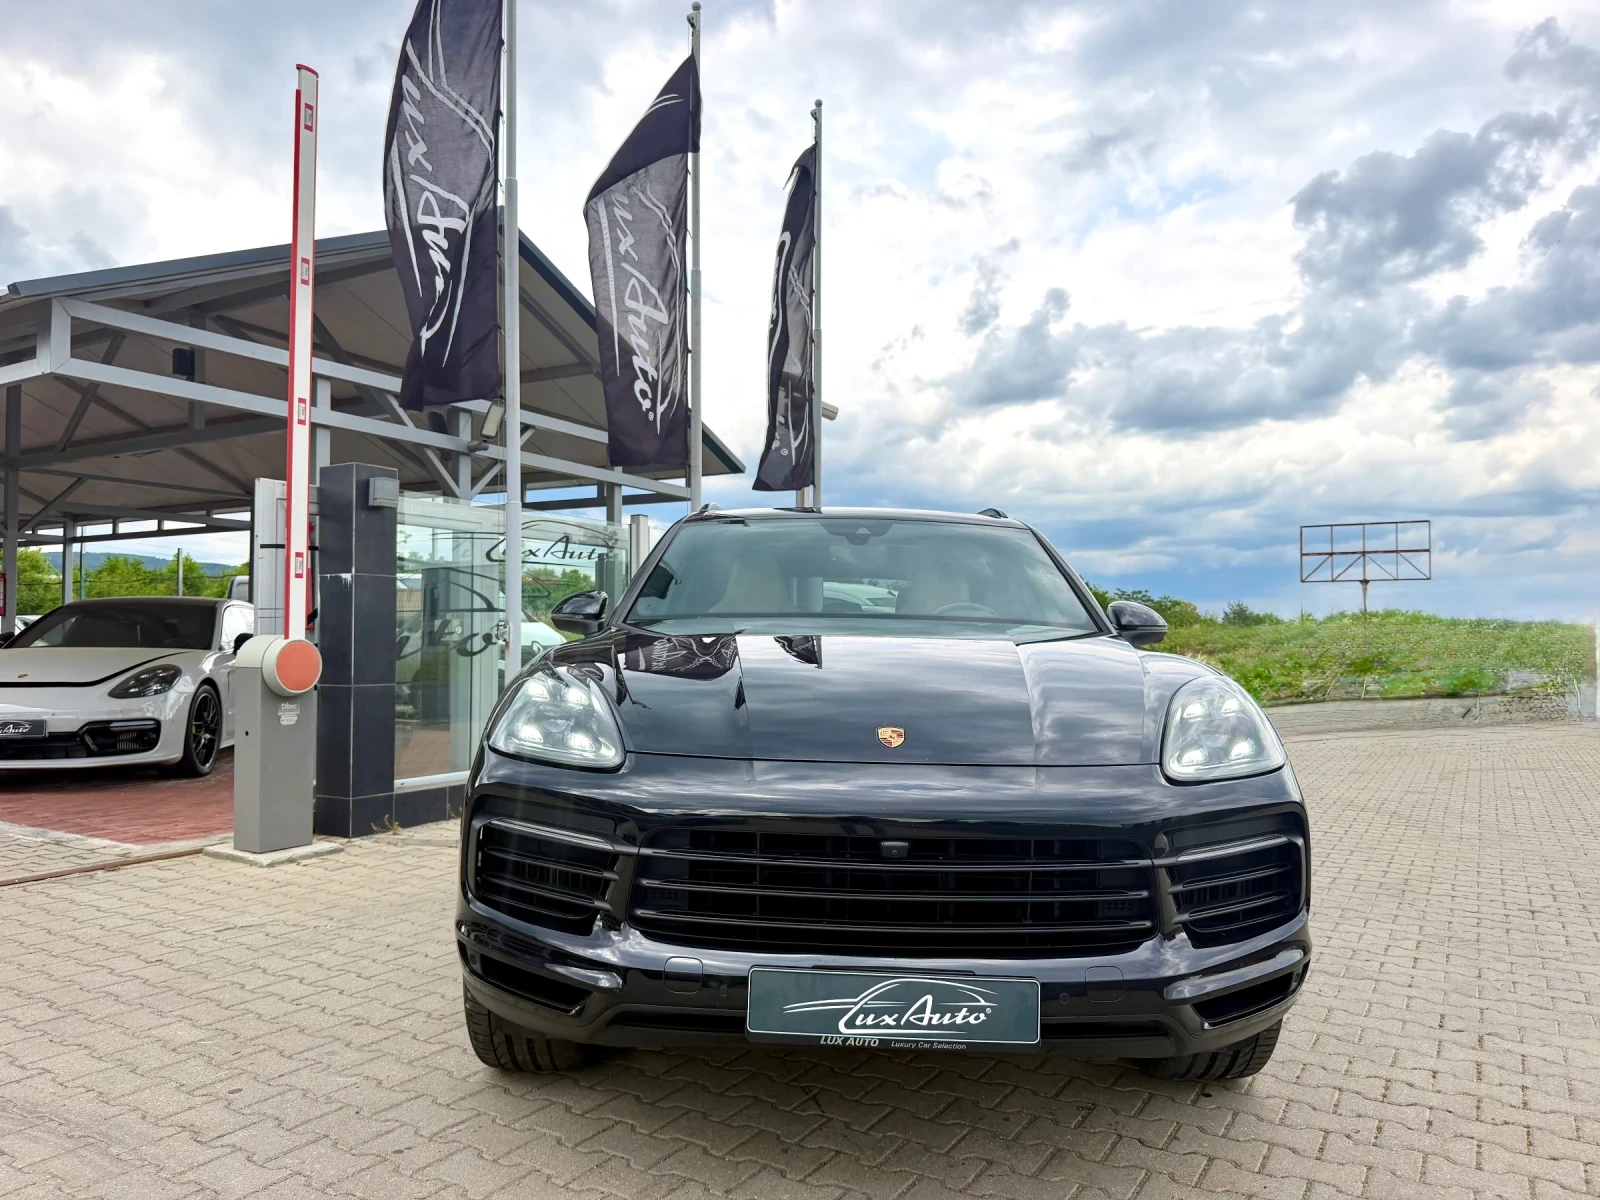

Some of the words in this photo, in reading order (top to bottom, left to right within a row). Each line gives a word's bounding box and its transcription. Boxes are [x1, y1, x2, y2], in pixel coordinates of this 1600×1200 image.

[820, 1035, 844, 1045] LUX
[846, 1037, 879, 1047] AUTO
[891, 1040, 916, 1049] Luxury
[918, 1041, 932, 1049] Car
[933, 1042, 967, 1050] Selection
